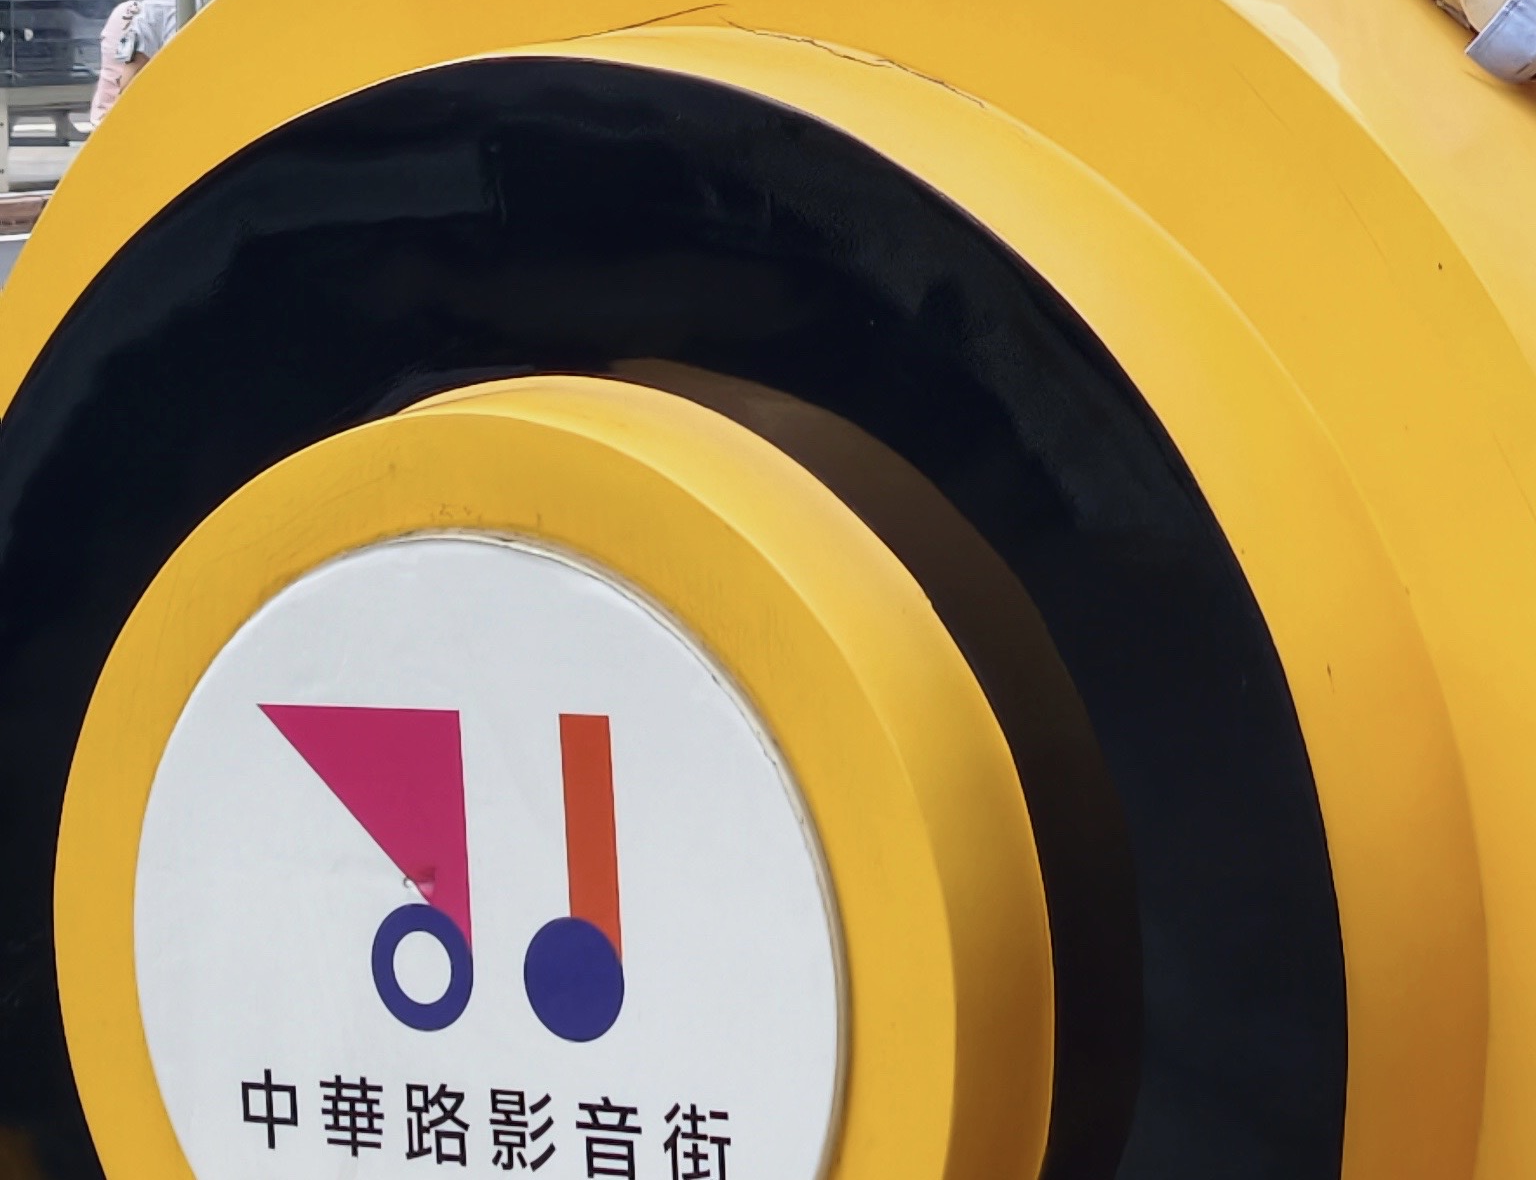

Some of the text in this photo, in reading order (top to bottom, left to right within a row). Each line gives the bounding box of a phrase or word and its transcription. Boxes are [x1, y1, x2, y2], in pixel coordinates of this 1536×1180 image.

[240, 1068, 732, 1180] 中華路影音街
